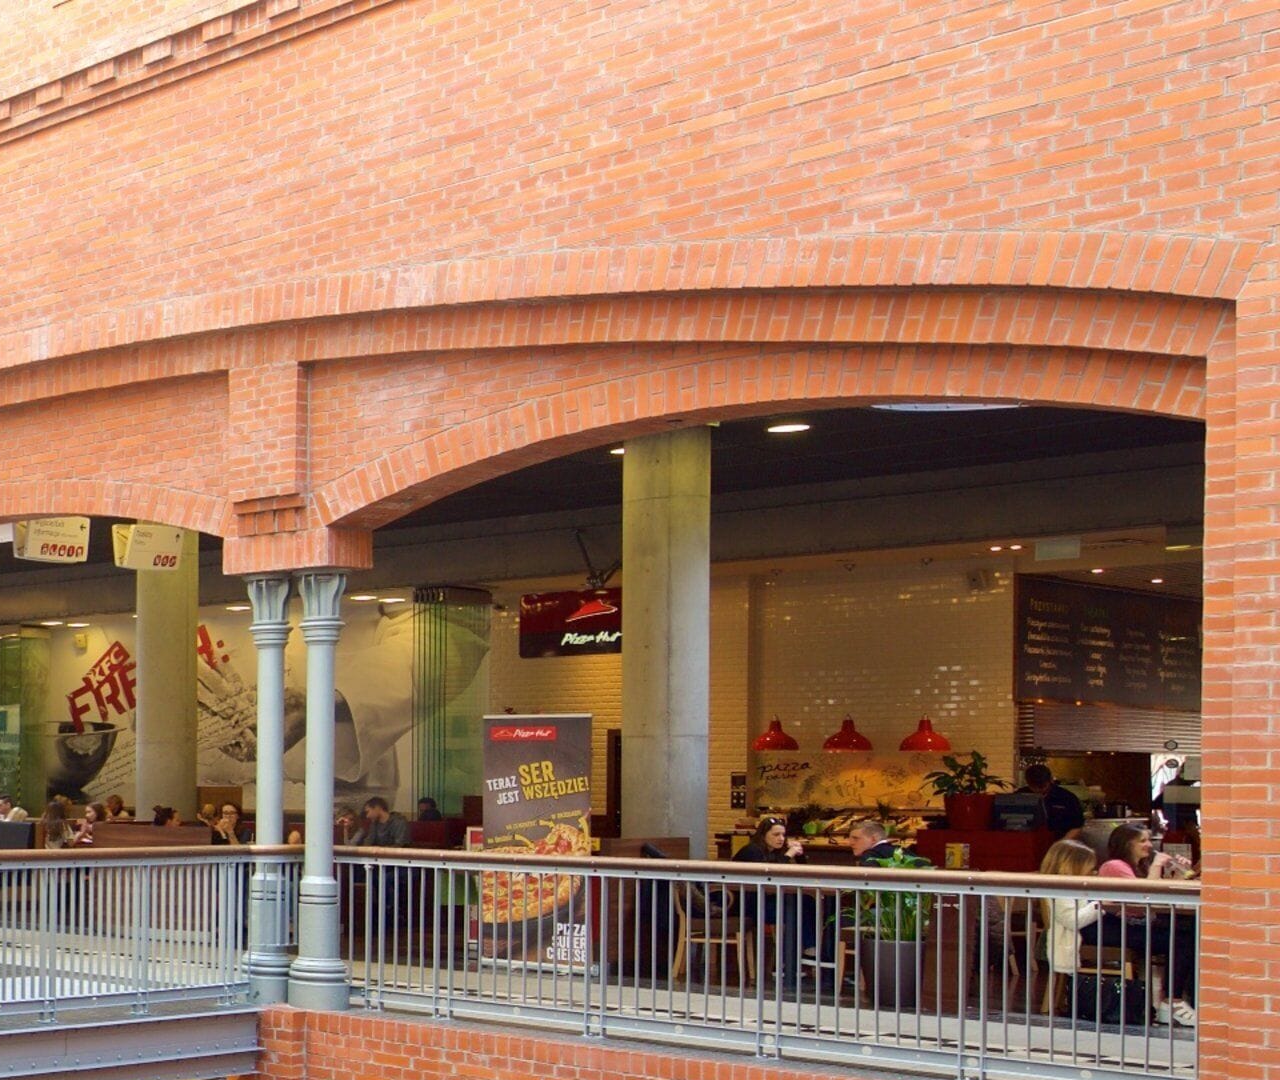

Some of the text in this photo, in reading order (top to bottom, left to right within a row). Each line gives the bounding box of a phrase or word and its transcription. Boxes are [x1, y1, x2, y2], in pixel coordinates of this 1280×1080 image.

[561, 631, 623, 646] Pizza Hut
[512, 729, 553, 738] Pizza Hut
[486, 760, 555, 791] TERAZ SER
[757, 762, 811, 780] pizza
[496, 776, 590, 805] JEST WSZĘDZIE!
